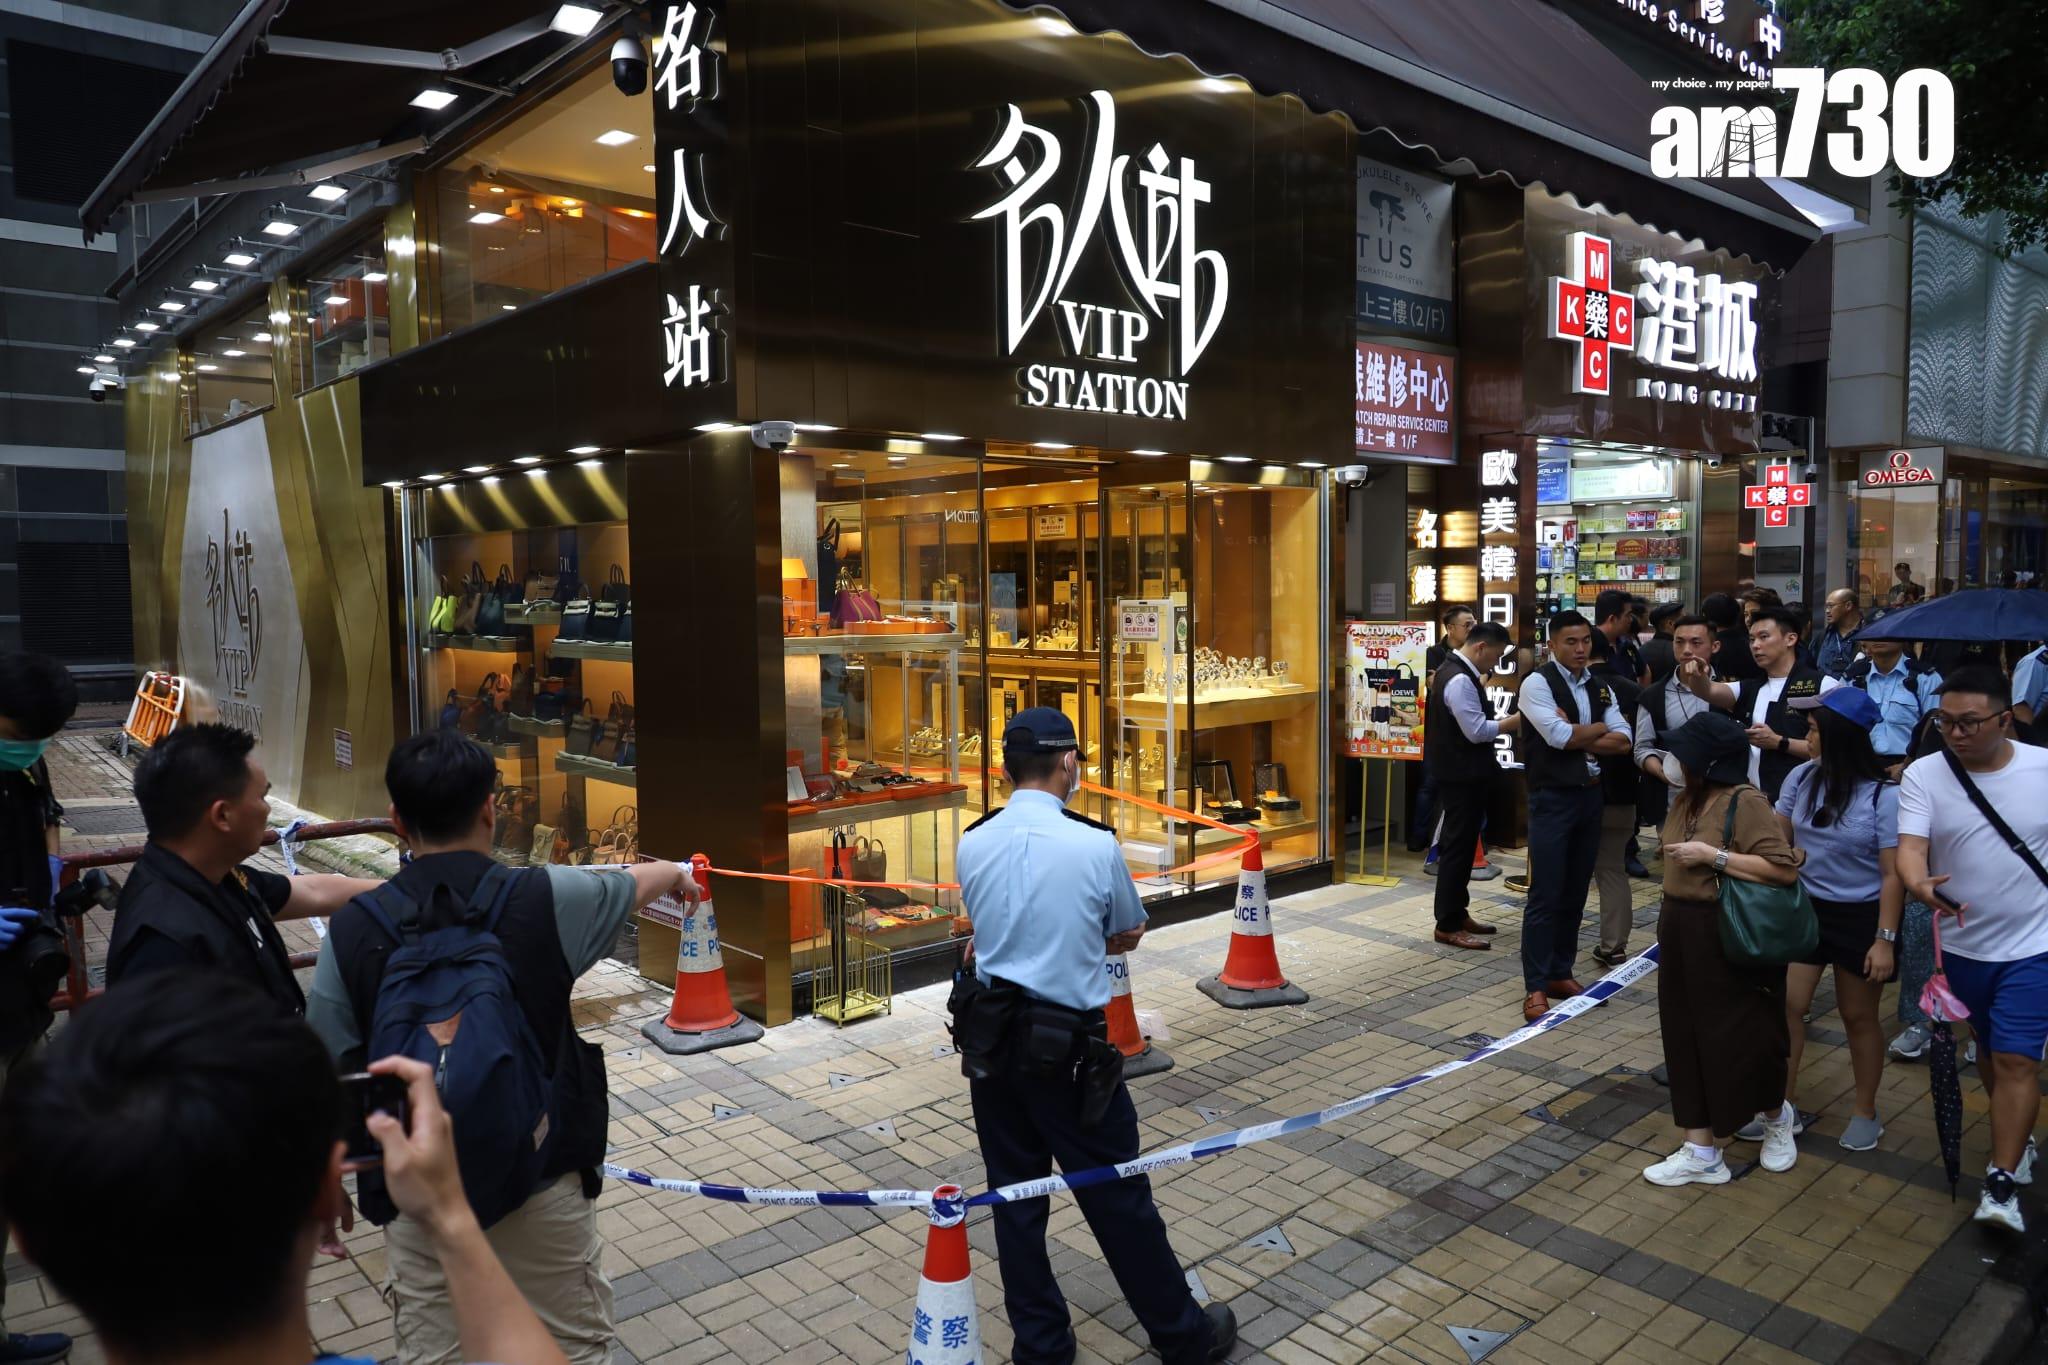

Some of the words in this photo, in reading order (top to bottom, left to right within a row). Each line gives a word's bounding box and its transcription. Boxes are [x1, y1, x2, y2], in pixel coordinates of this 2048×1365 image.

[1668, 9, 1733, 64] Service
[654, 1, 711, 388] 名人站
[1404, 181, 1433, 224] STORE
[972, 90, 1230, 378] 名人站
[1590, 250, 1605, 280] M
[1058, 299, 1149, 363] VIP
[1566, 294, 1580, 325] K
[1584, 290, 1609, 339] 藥
[1615, 306, 1628, 335] C
[1638, 257, 1758, 382] 港城
[1589, 350, 1602, 379] C
[1025, 364, 1189, 421] STATION
[1639, 378, 1699, 405] KONG
[1710, 389, 1757, 413] CITY
[1374, 411, 1397, 428] REPAIR
[1397, 415, 1424, 431] SERVICE
[1424, 418, 1449, 434] CENTER
[1401, 434, 1418, 450] 1/F
[1752, 490, 1763, 503] K
[1793, 489, 1804, 501] C
[1771, 470, 1784, 483] M
[1864, 467, 1935, 486] OMEGA
[1771, 509, 1782, 522] C
[221, 647, 250, 692] VIP
[1124, 1161, 1153, 1176] POLICE
[913, 1306, 969, 1349] 警察
